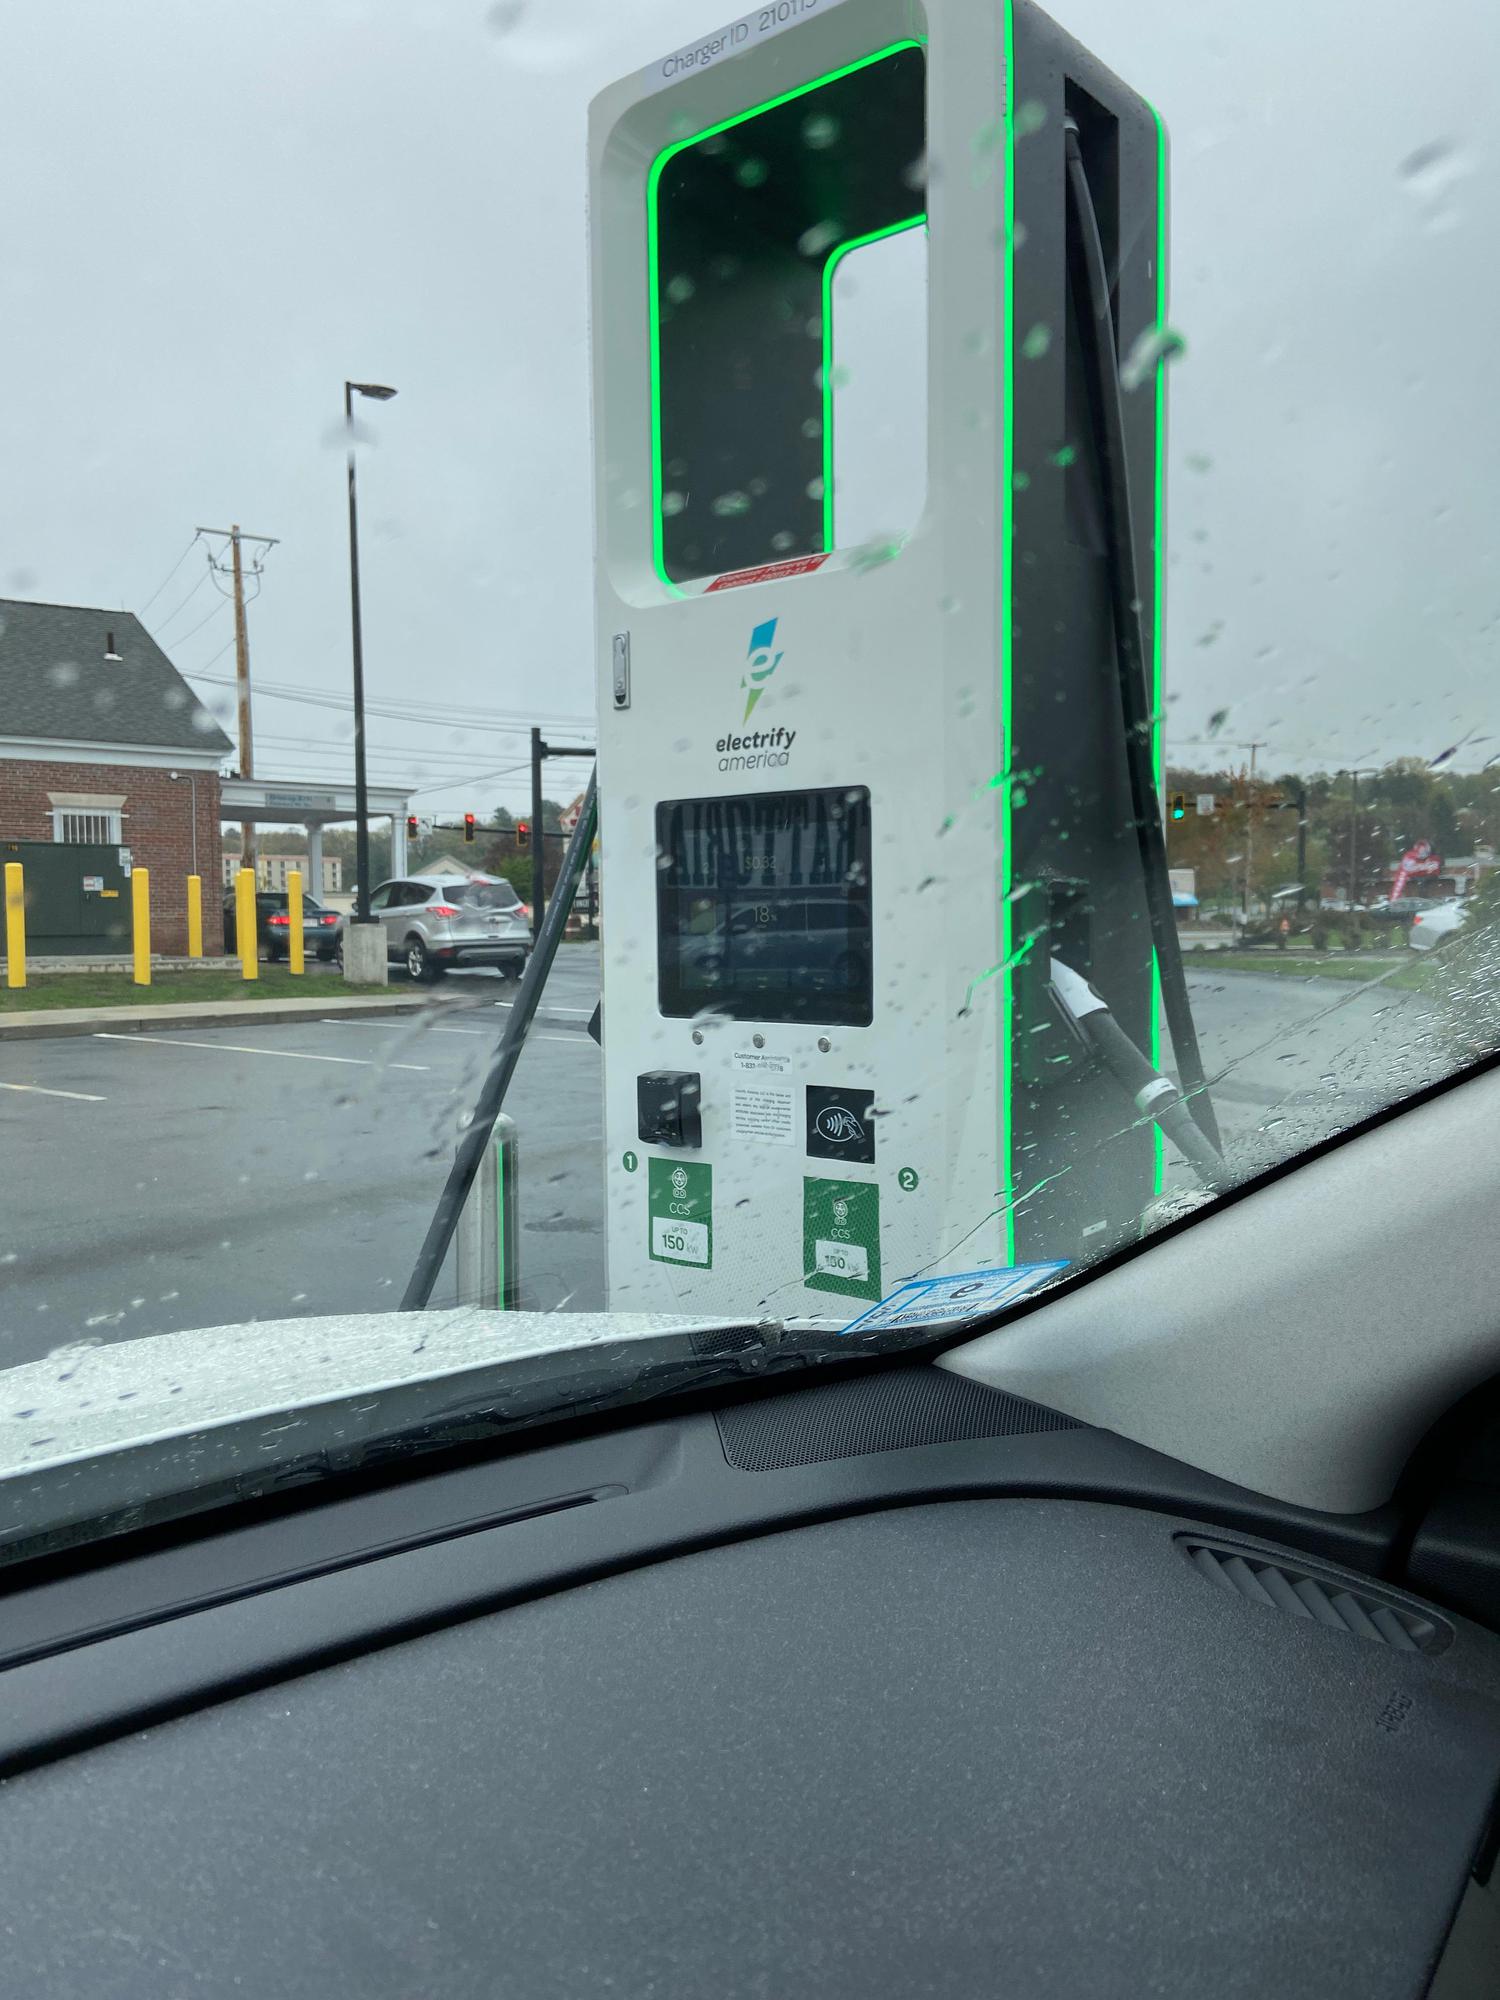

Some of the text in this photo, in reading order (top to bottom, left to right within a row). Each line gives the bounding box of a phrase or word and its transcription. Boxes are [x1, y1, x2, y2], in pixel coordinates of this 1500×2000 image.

[661, 34, 727, 78] Charger
[730, 23, 749, 46] ID
[716, 727, 796, 752] electrify
[718, 750, 789, 772] america
[903, 1171, 914, 1188] 2
[669, 1202, 690, 1216] CCS
[831, 1228, 850, 1239] CCS
[662, 1234, 685, 1252] 150
